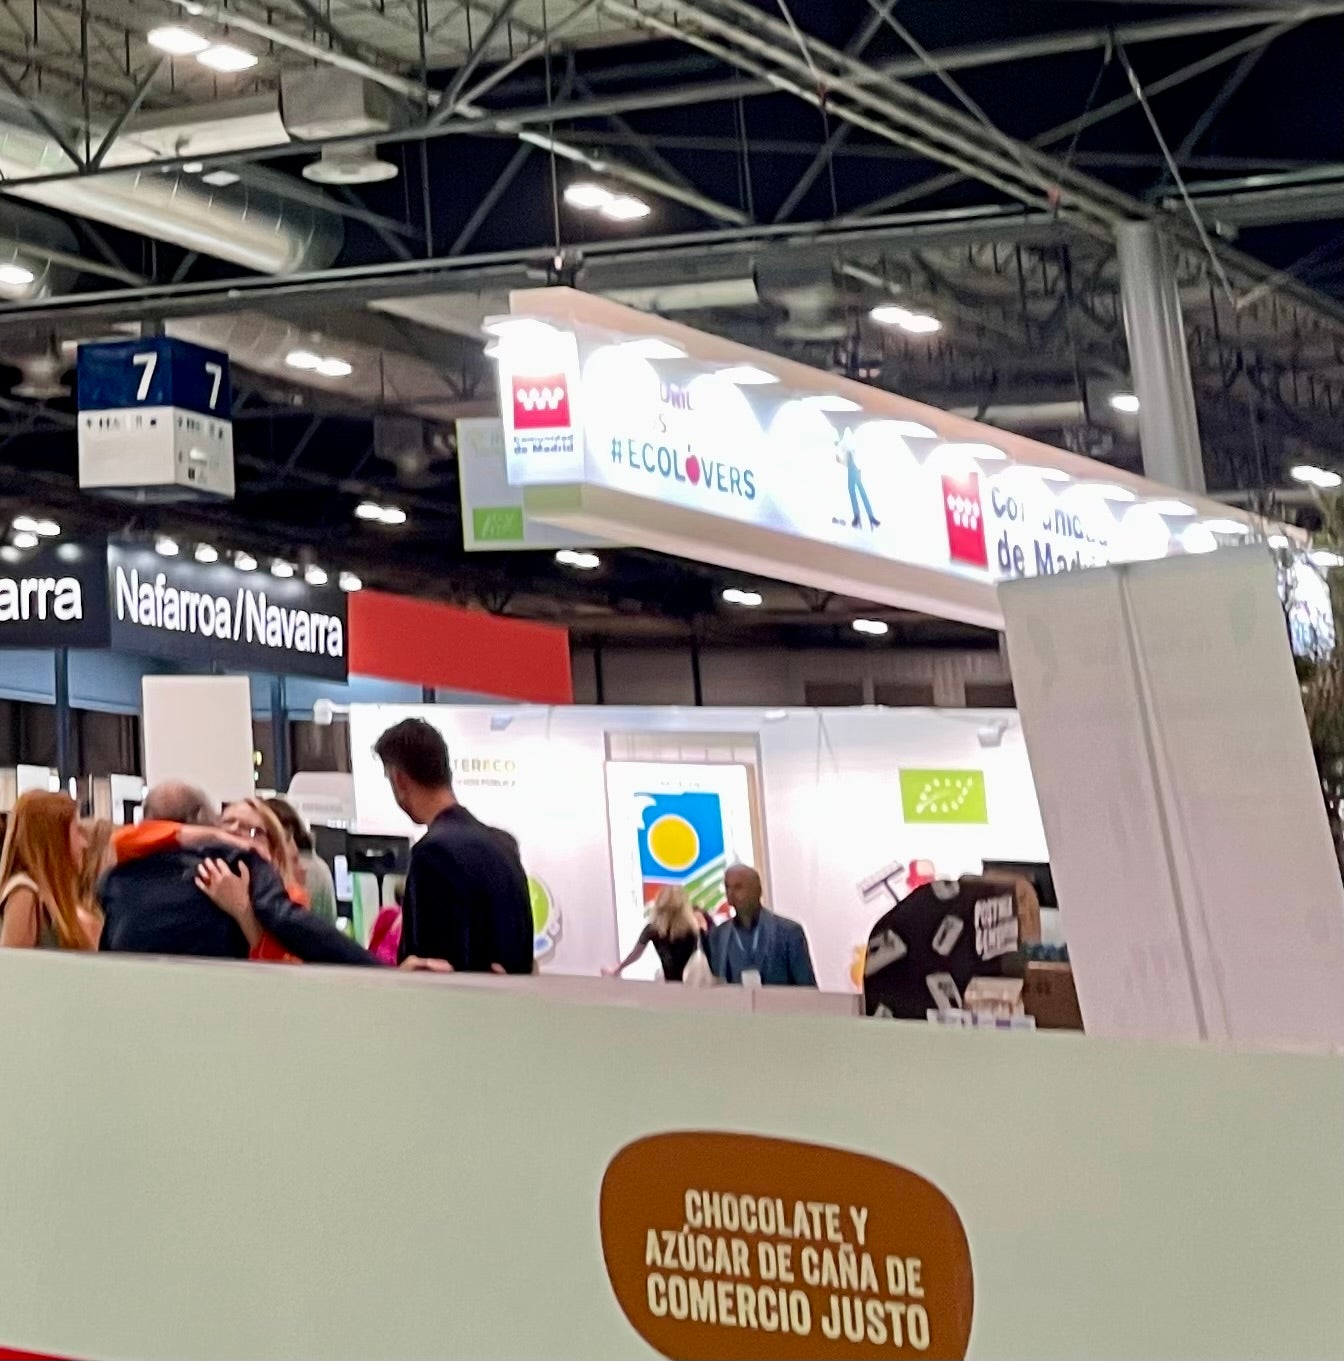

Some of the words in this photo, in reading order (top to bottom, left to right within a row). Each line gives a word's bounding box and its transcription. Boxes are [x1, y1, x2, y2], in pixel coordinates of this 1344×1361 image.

[133, 351, 158, 401] 7
[205, 361, 223, 410] 7
[116, 565, 343, 658] Nafarroa/Navarra
[684, 1189, 841, 1244] CHOCOLATE
[850, 1206, 868, 1246] Y
[645, 1224, 751, 1279] AZÚCAR
[757, 1242, 795, 1283] DE
[801, 1243, 879, 1295] CAÑA
[885, 1255, 925, 1298] DE
[646, 1273, 812, 1336] COMERCIO
[822, 1295, 931, 1352] JUSTO
